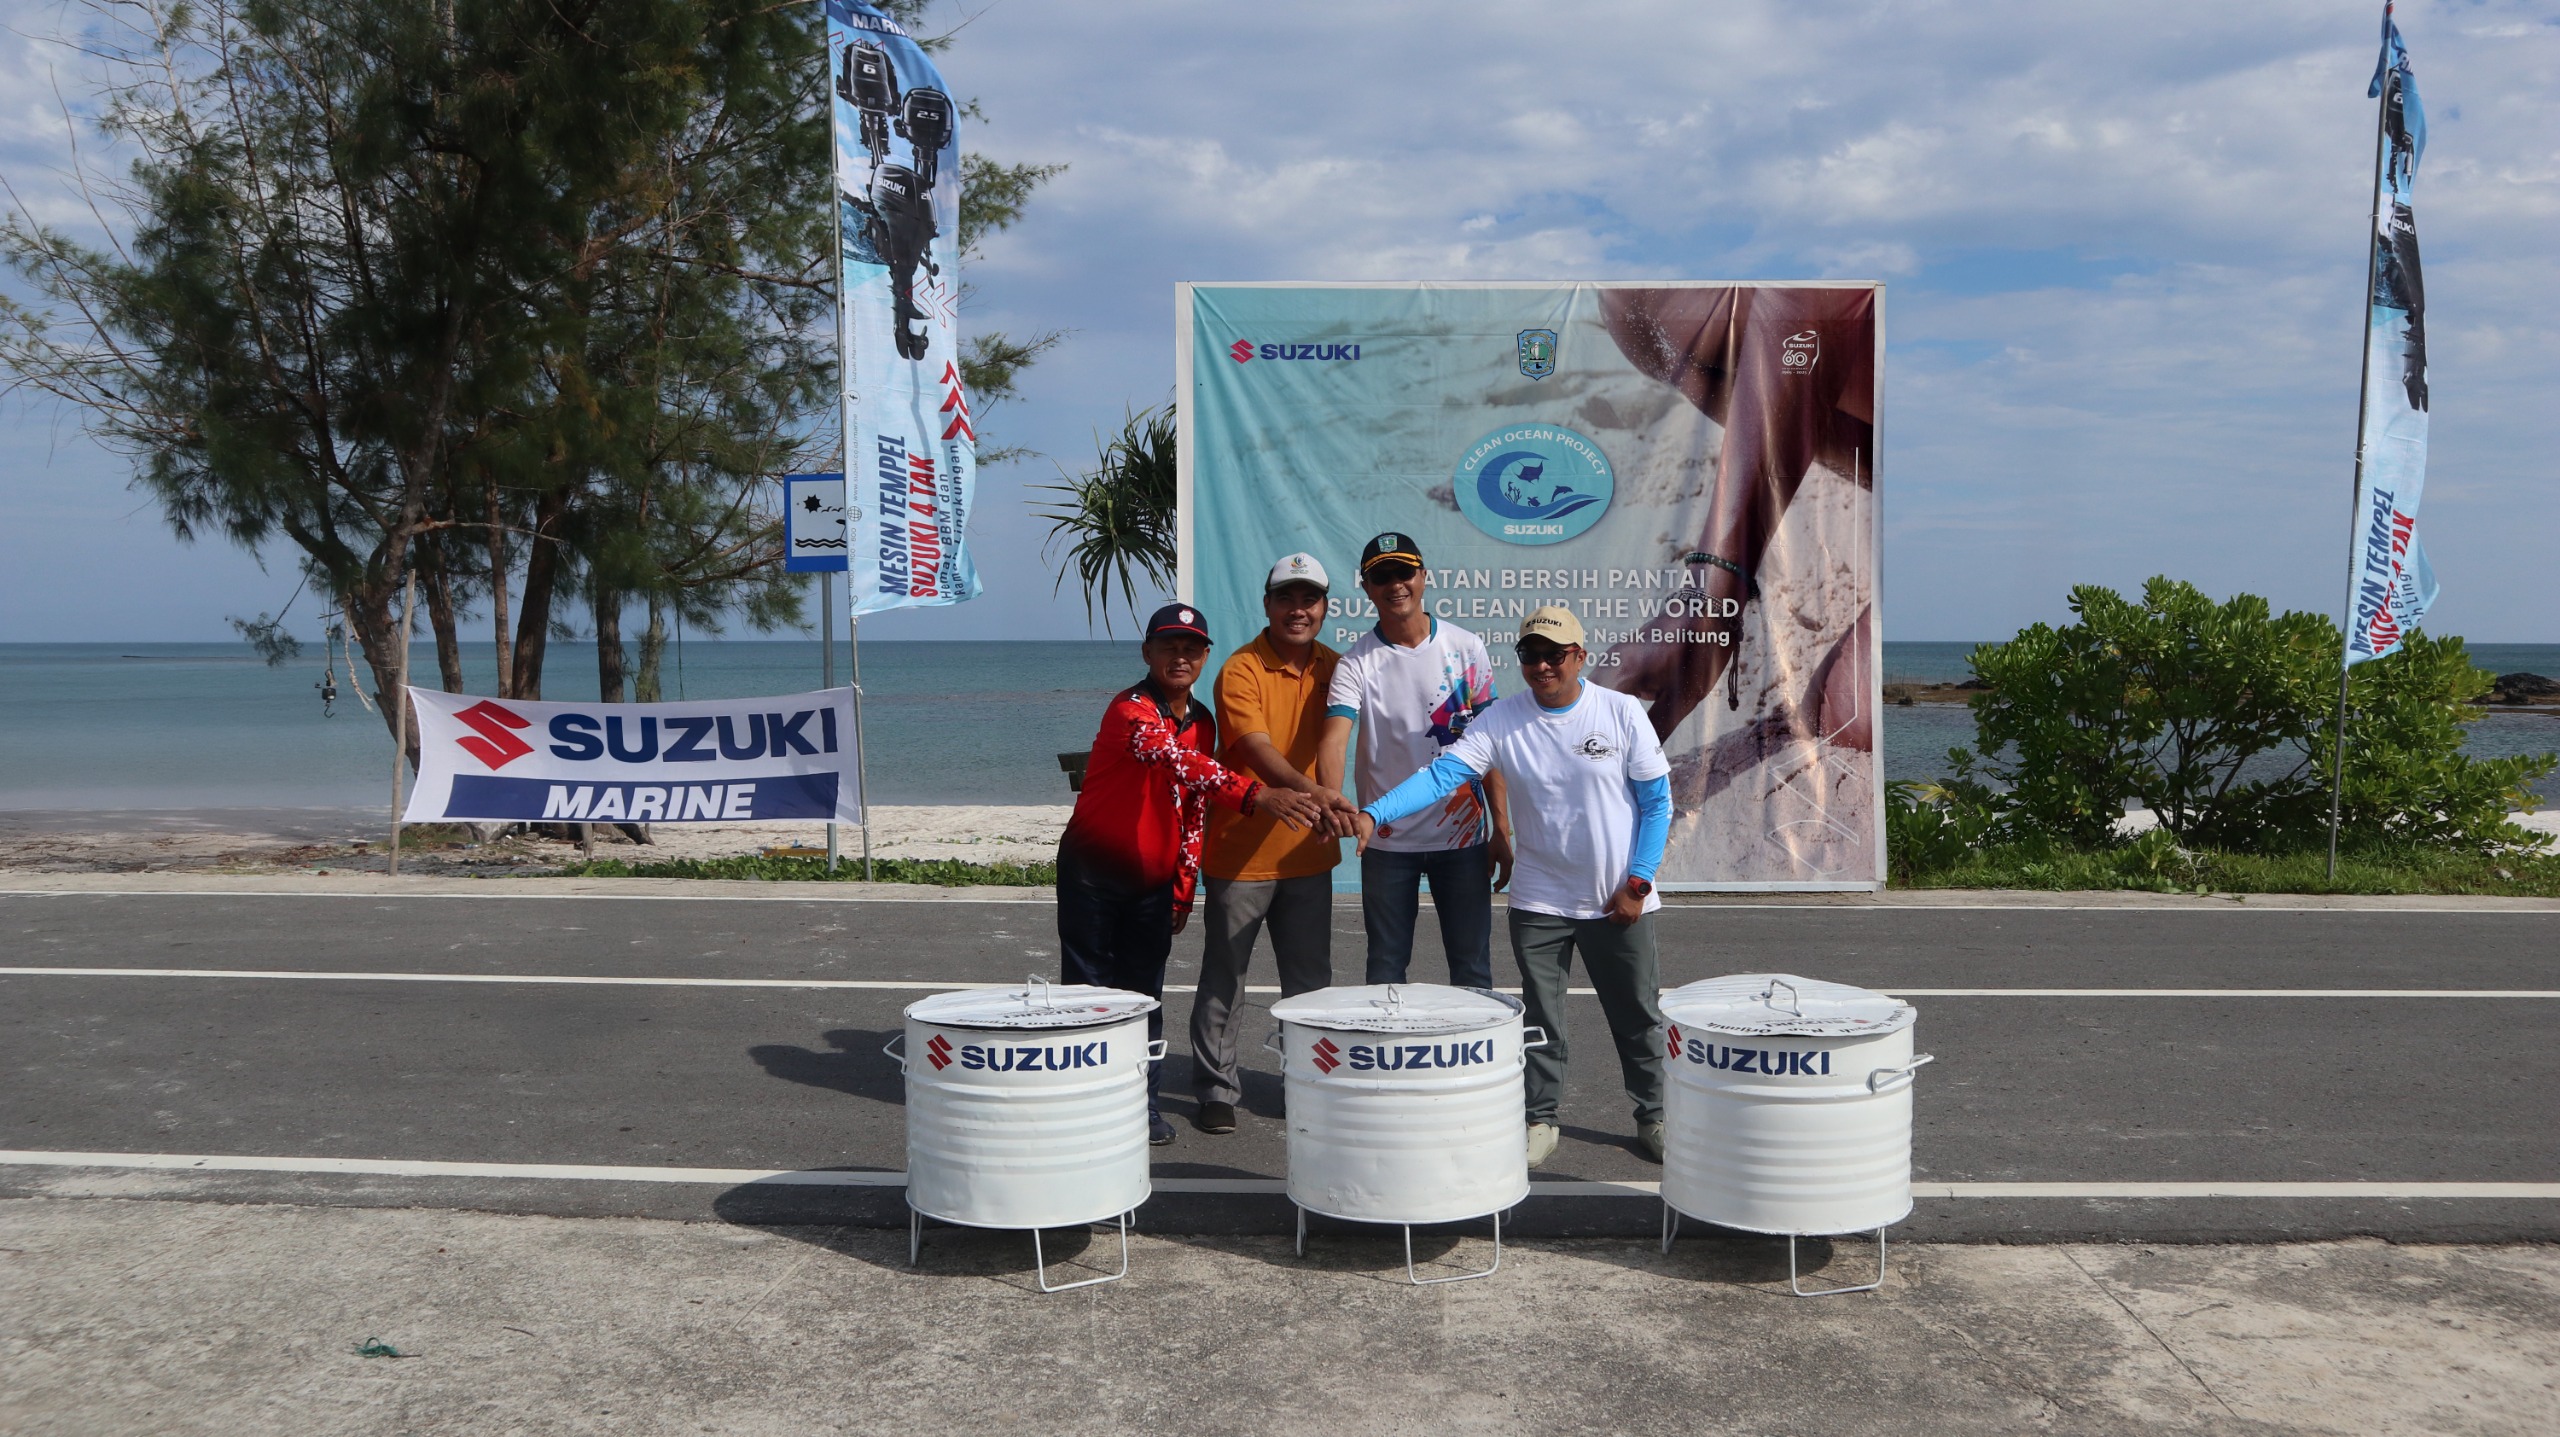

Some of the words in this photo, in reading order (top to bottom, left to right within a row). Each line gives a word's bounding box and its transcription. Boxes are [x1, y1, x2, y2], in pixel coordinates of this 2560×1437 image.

[863, 63, 876, 74] 6
[917, 110, 939, 121] 2.5
[876, 177, 906, 196] SUZUKI
[1260, 343, 1360, 361] SUZUKI
[1782, 349, 1808, 366] 60
[1464, 436, 1502, 471] CLEAN
[1504, 429, 1553, 443] OCEAN
[1555, 433, 1606, 476] PROJECT
[877, 434, 907, 519] TEMPEL
[908, 452, 937, 496] TAK
[939, 473, 950, 503] dan
[909, 501, 938, 517] 4
[950, 444, 965, 545] Lingkungan
[940, 510, 952, 546] BBM
[1504, 524, 1563, 535] SUZUKI
[2366, 486, 2394, 577] TEMPEL
[879, 521, 909, 596] MESIN
[909, 520, 941, 598] SUZUKI
[940, 553, 952, 600] Hemat
[1501, 569, 1598, 589] BERSIH
[1609, 569, 1705, 589] PANTAI
[1327, 598, 1425, 618] SUZI
[1435, 598, 1525, 618] CLEAN
[1579, 598, 1629, 618] THE
[1638, 598, 1739, 618] WORLD
[1531, 618, 1562, 628] SUZUKI
[1595, 628, 1645, 643] Nasik
[1651, 628, 1730, 646] Belitung
[1585, 652, 1621, 667] 025
[548, 707, 838, 762] SUZUKI
[541, 783, 756, 820] MARINE
[961, 1041, 1107, 1071] SUZUKI
[1349, 1039, 1493, 1070] SUZUKI
[1686, 1038, 1830, 1075] SUZUKI
